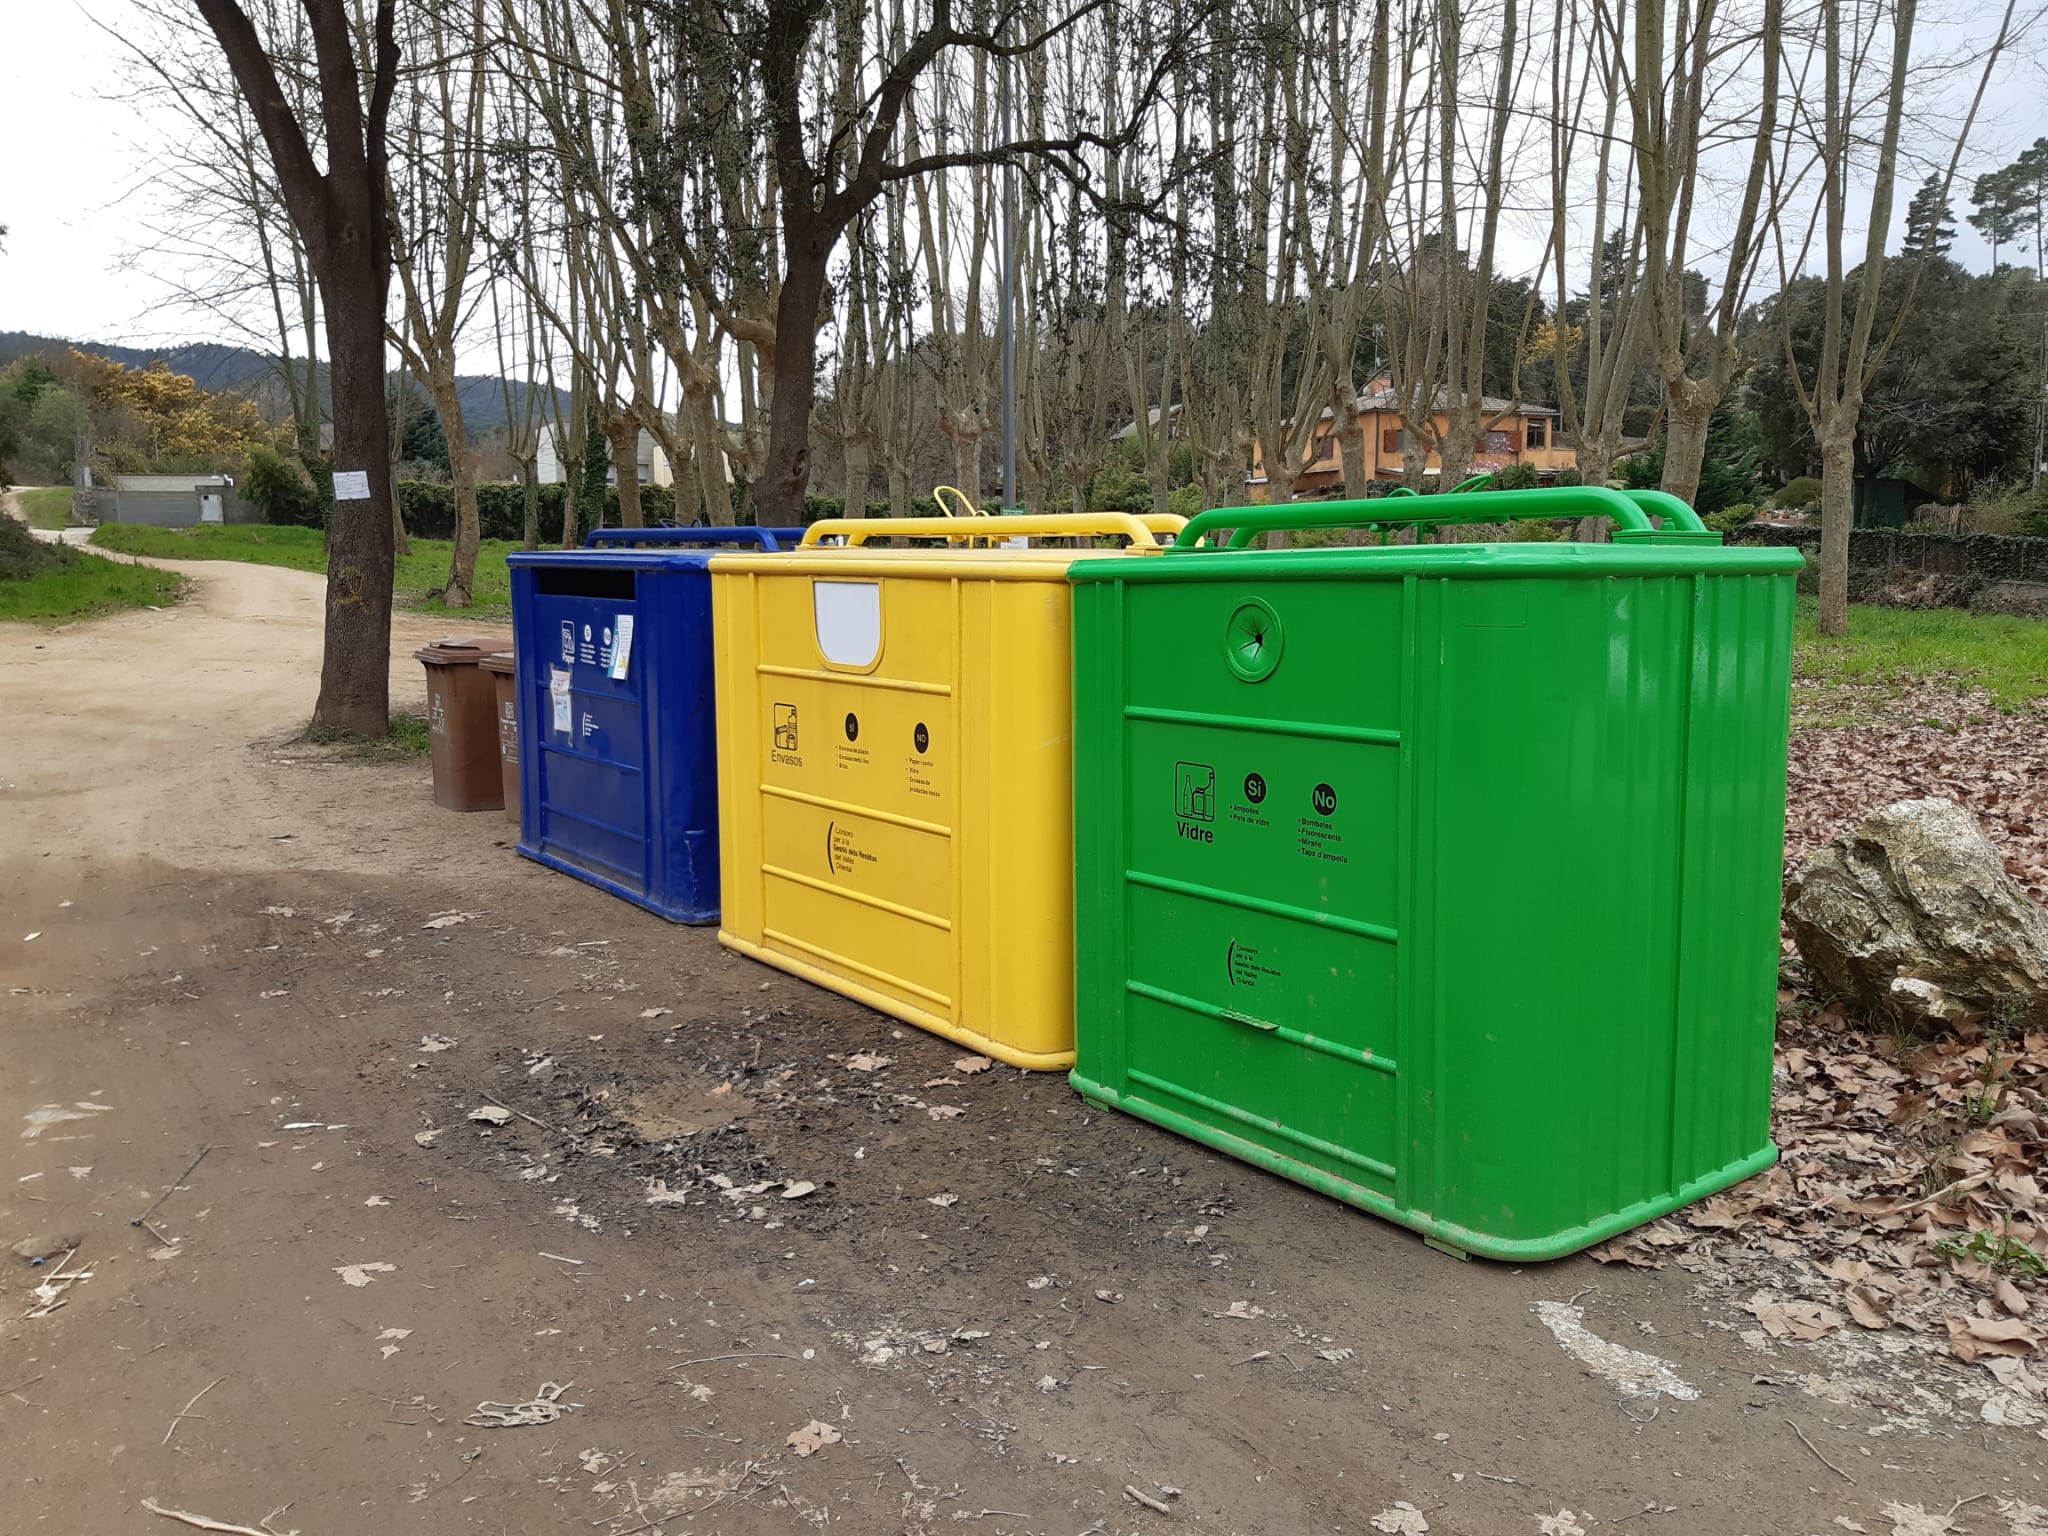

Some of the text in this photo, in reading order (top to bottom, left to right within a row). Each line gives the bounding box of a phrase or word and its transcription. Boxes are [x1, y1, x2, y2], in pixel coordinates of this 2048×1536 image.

[916, 733, 926, 743] NO
[771, 749, 803, 767] Envasos
[1248, 780, 1262, 797] Sí
[1314, 790, 1335, 809] No
[1177, 821, 1214, 843] Vidre
[1255, 819, 1270, 828] vidre
